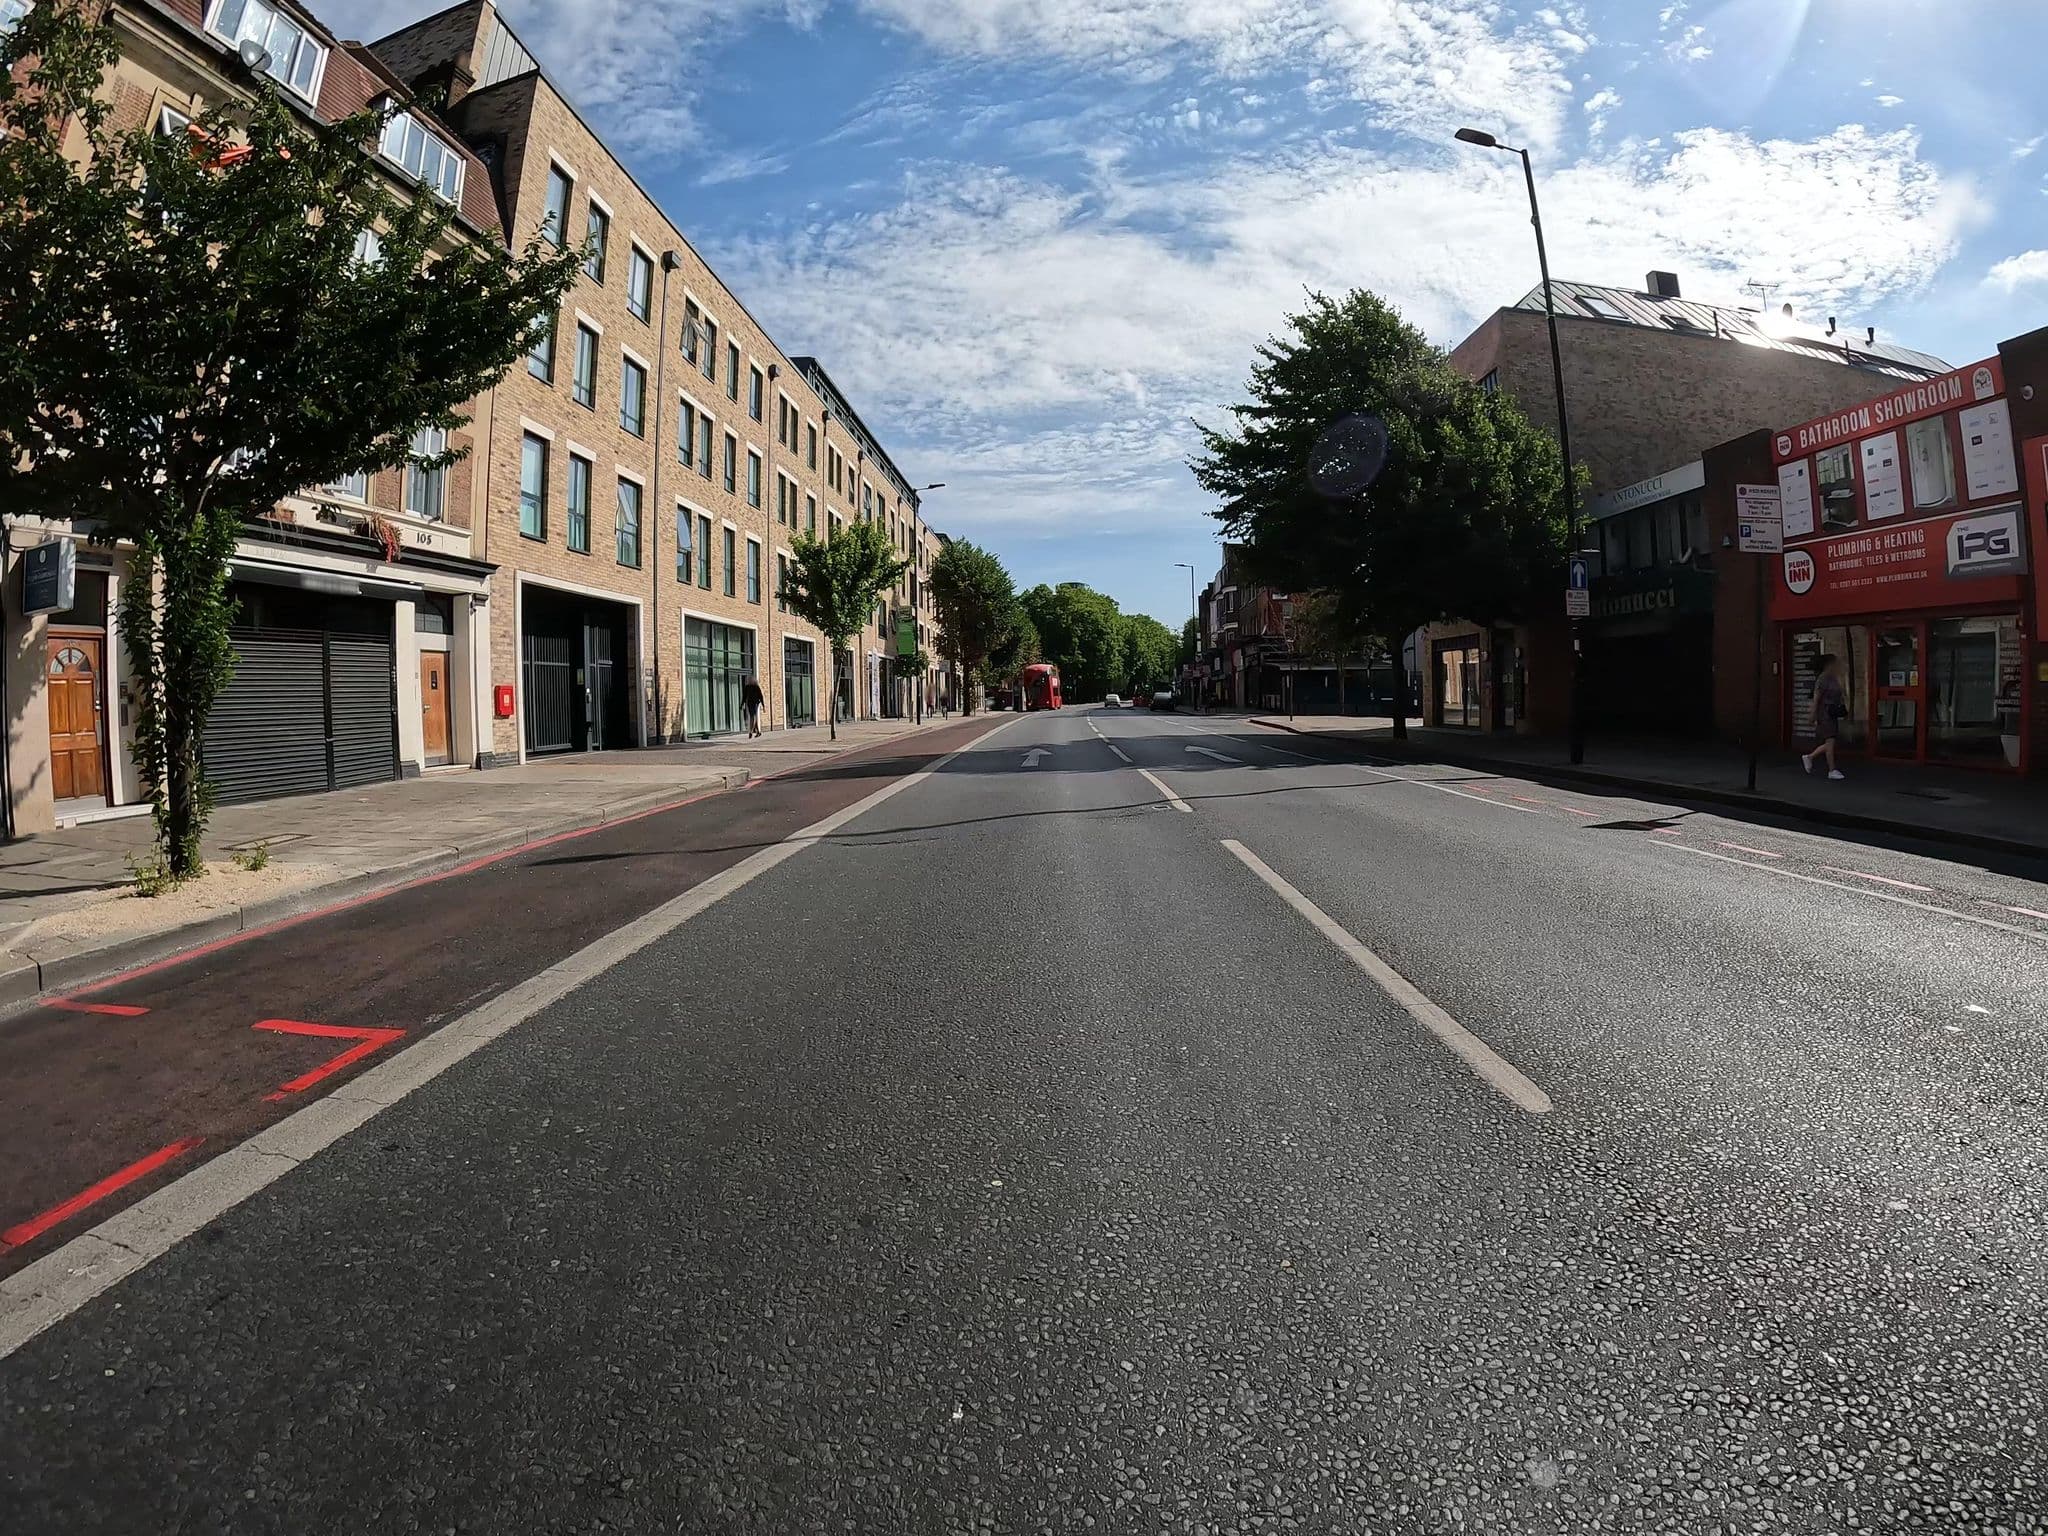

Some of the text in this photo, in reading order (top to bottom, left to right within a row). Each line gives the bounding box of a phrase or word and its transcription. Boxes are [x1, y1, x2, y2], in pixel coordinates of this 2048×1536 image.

[1799, 375, 1963, 449] BATHROOM SHOWROOM
[1612, 476, 1665, 504] ANTONUCCI
[416, 532, 432, 546] 105
[1742, 526, 1750, 537] P
[1828, 528, 1925, 558] PLUMBING & HEATING
[1957, 527, 2010, 560] IPG
[1788, 559, 1810, 569] PLUMB
[1828, 558, 1865, 572] BATHROOMS,
[1866, 555, 1883, 566] TILES
[1890, 548, 1927, 562] WETROOMS
[1789, 568, 1811, 583] INN
